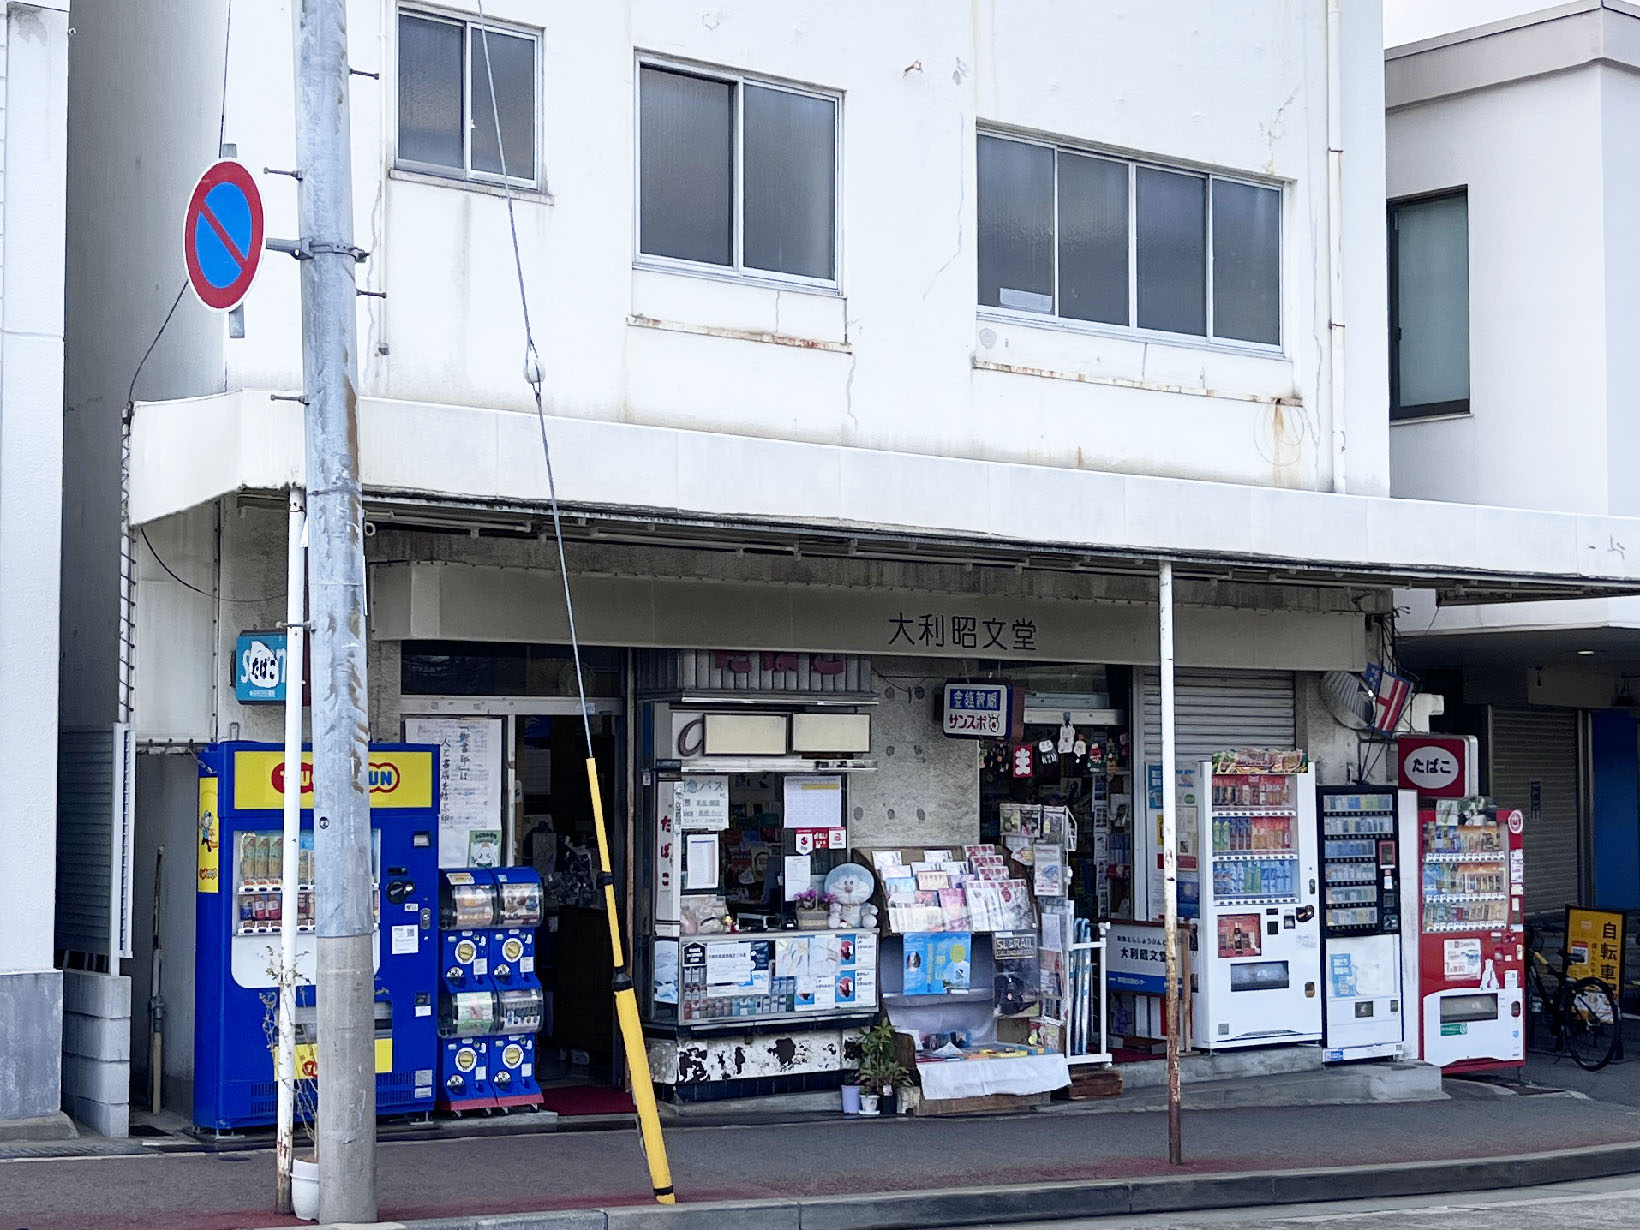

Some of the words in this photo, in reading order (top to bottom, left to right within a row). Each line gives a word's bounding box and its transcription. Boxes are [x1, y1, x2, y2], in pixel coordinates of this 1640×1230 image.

[888, 611, 1037, 651] 大利昭文堂
[949, 714, 987, 730] サンスポ
[1412, 757, 1451, 774] たばこ
[660, 815, 672, 887] たばこ
[1600, 921, 1618, 991] 自転車
